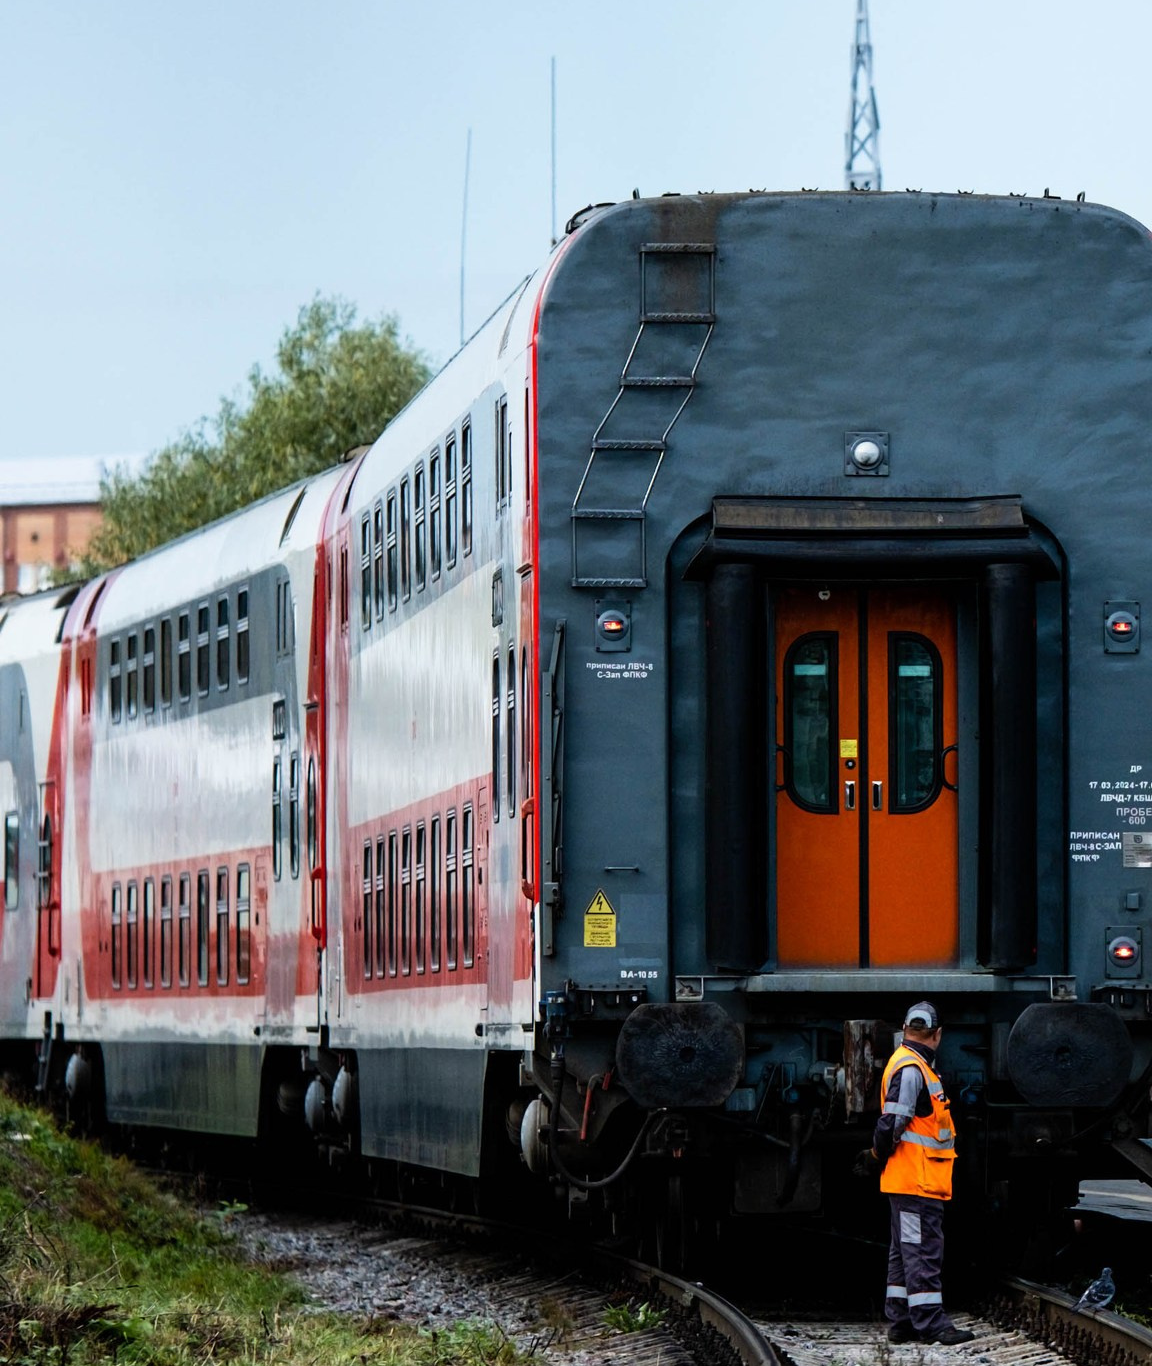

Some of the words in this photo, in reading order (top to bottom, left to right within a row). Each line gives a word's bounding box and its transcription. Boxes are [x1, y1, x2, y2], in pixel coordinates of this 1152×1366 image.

[1130, 765, 1142, 773] ДР
[1133, 794, 1152, 802] КБШ
[1128, 816, 1146, 825] 600
[1070, 831, 1120, 840] ПРИПИСАН
[1071, 854, 1100, 862] ФПКФ
